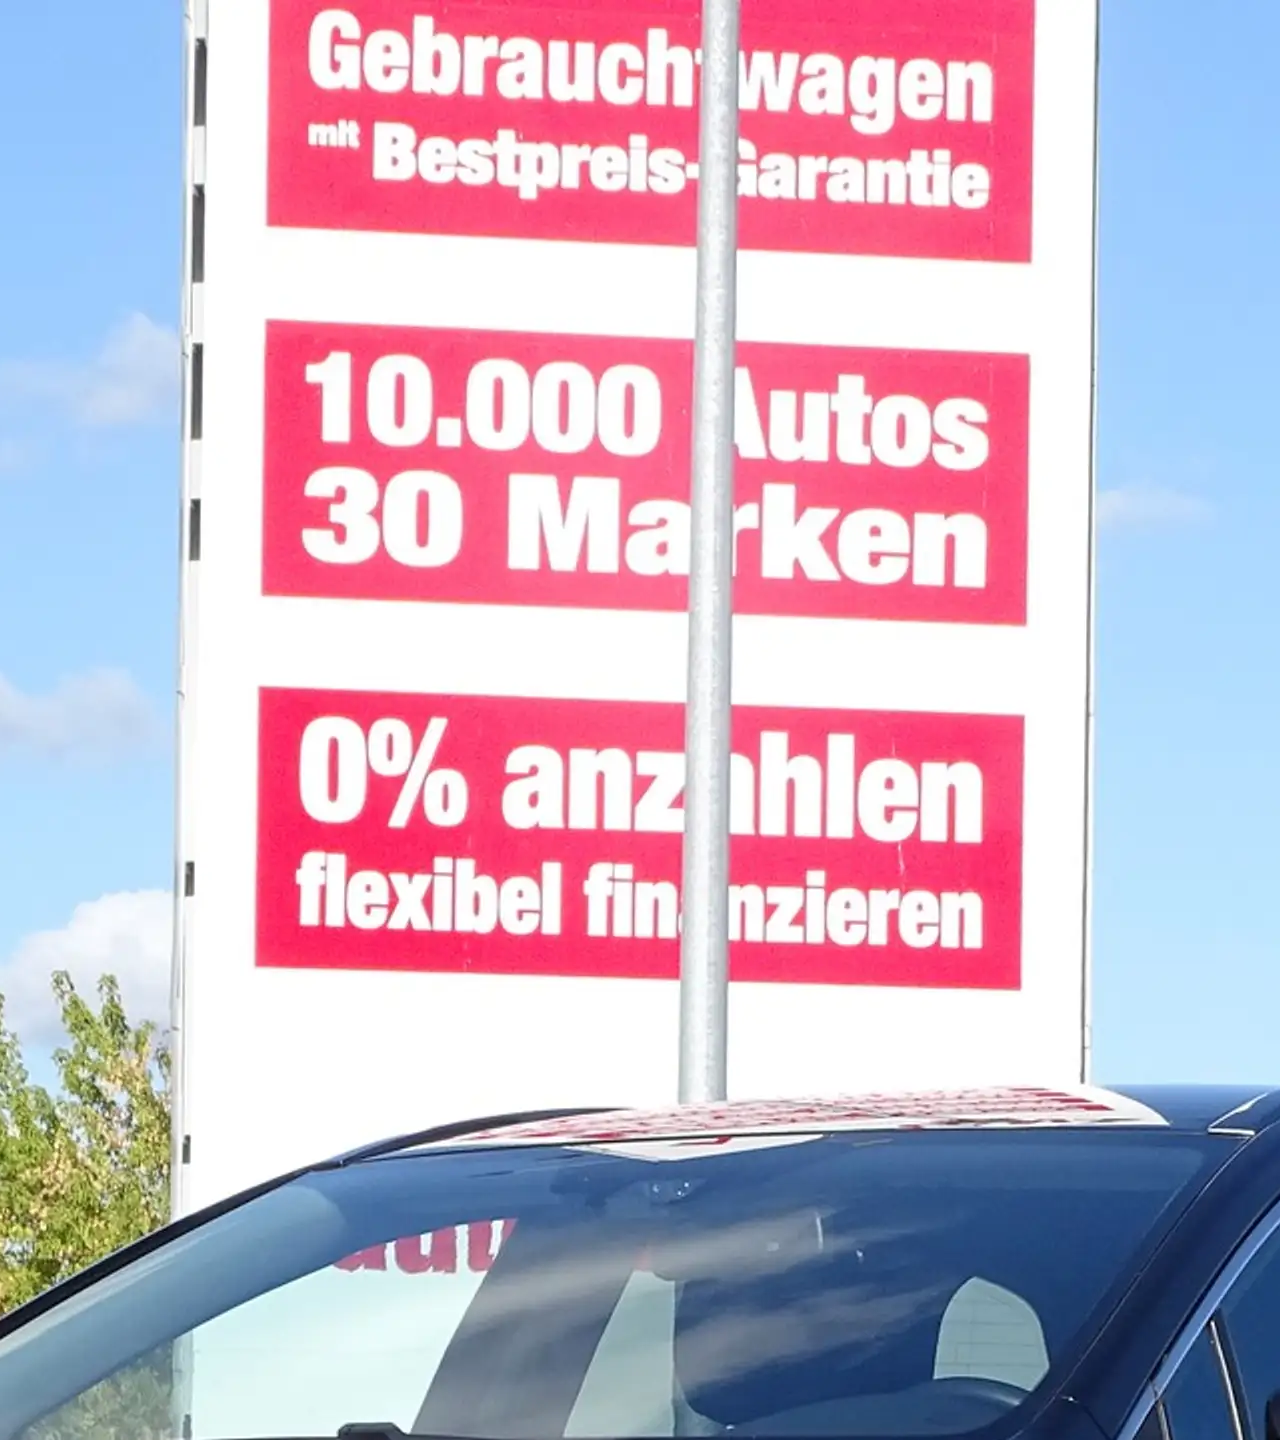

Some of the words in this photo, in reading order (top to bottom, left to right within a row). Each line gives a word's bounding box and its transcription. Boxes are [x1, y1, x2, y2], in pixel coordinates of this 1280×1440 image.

[308, 9, 994, 135] Gebrauchwagen
[308, 119, 361, 149] mit
[305, 351, 662, 457] 10.000
[301, 466, 464, 568] 30
[299, 716, 468, 828] 0%
[295, 851, 562, 935] flexibel
[583, 862, 983, 949] finnzieren
